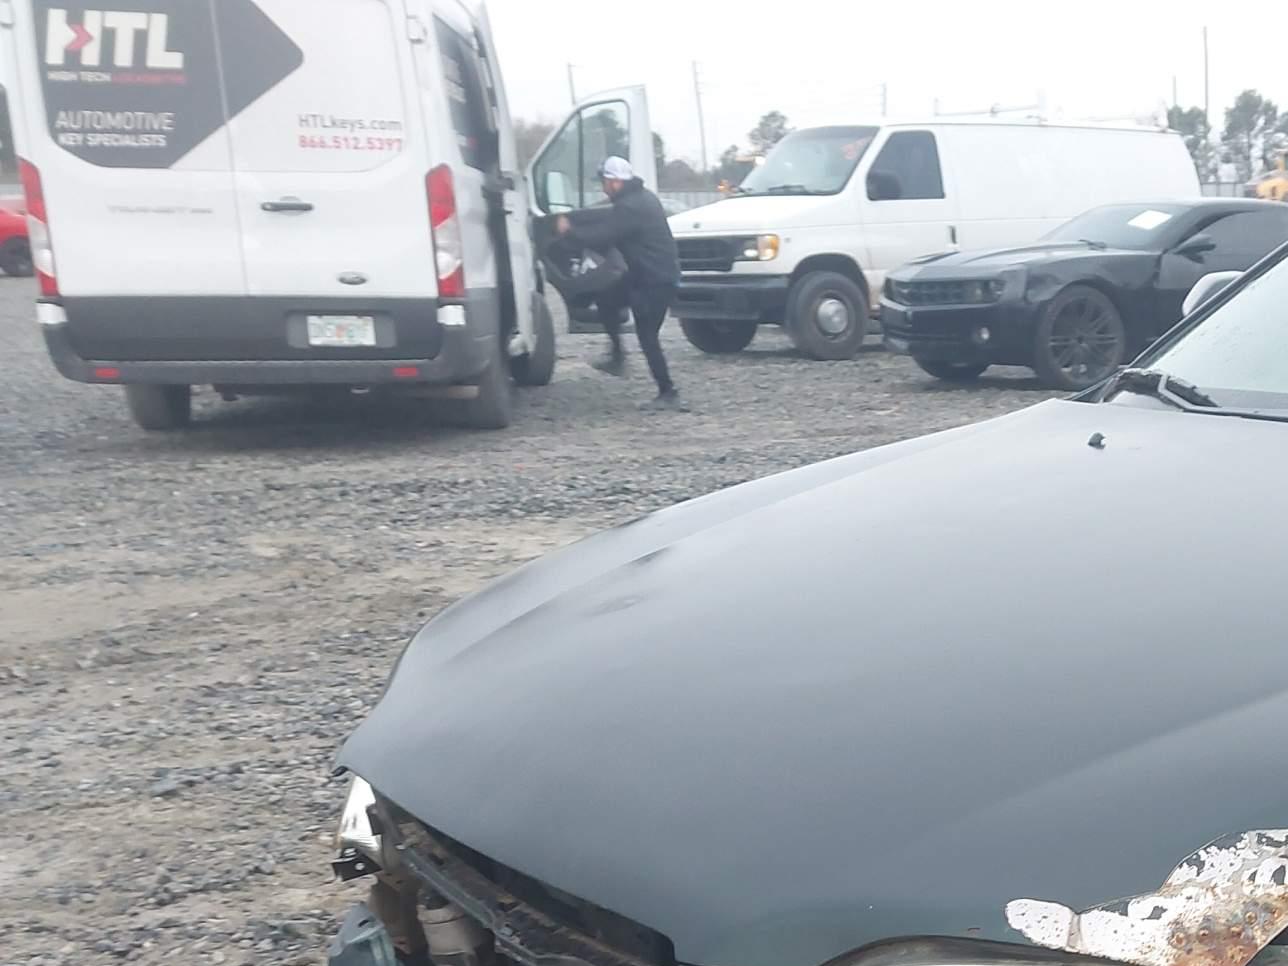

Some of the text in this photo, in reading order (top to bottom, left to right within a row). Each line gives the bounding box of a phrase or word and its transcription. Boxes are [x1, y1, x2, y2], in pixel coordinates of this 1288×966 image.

[45, 8, 184, 69] HTL
[55, 110, 176, 131] AUTOMOTIVE
[298, 113, 401, 132] HTLkeys.com
[57, 132, 167, 147] KEY SPECIALISTS
